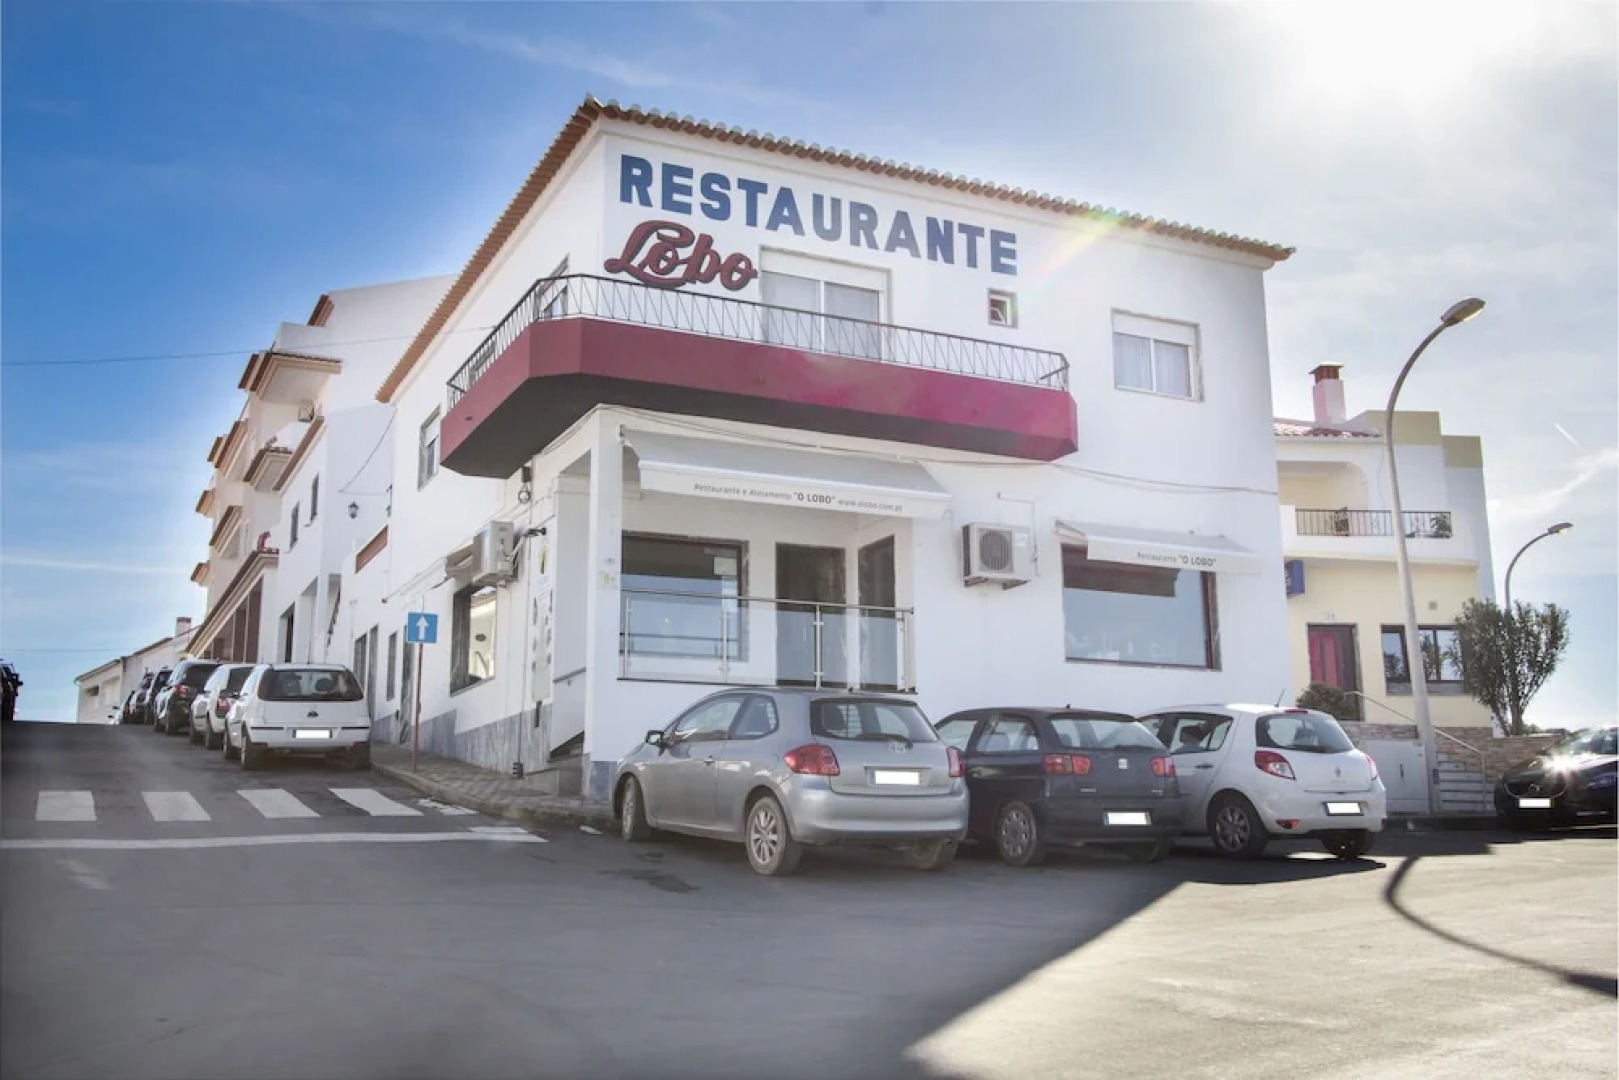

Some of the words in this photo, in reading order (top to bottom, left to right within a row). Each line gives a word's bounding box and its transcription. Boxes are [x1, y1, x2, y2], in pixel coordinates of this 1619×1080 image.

[619, 154, 1018, 275] RESTAURANTE
[604, 219, 758, 290] Lobo
[694, 483, 740, 495] Restaurante
